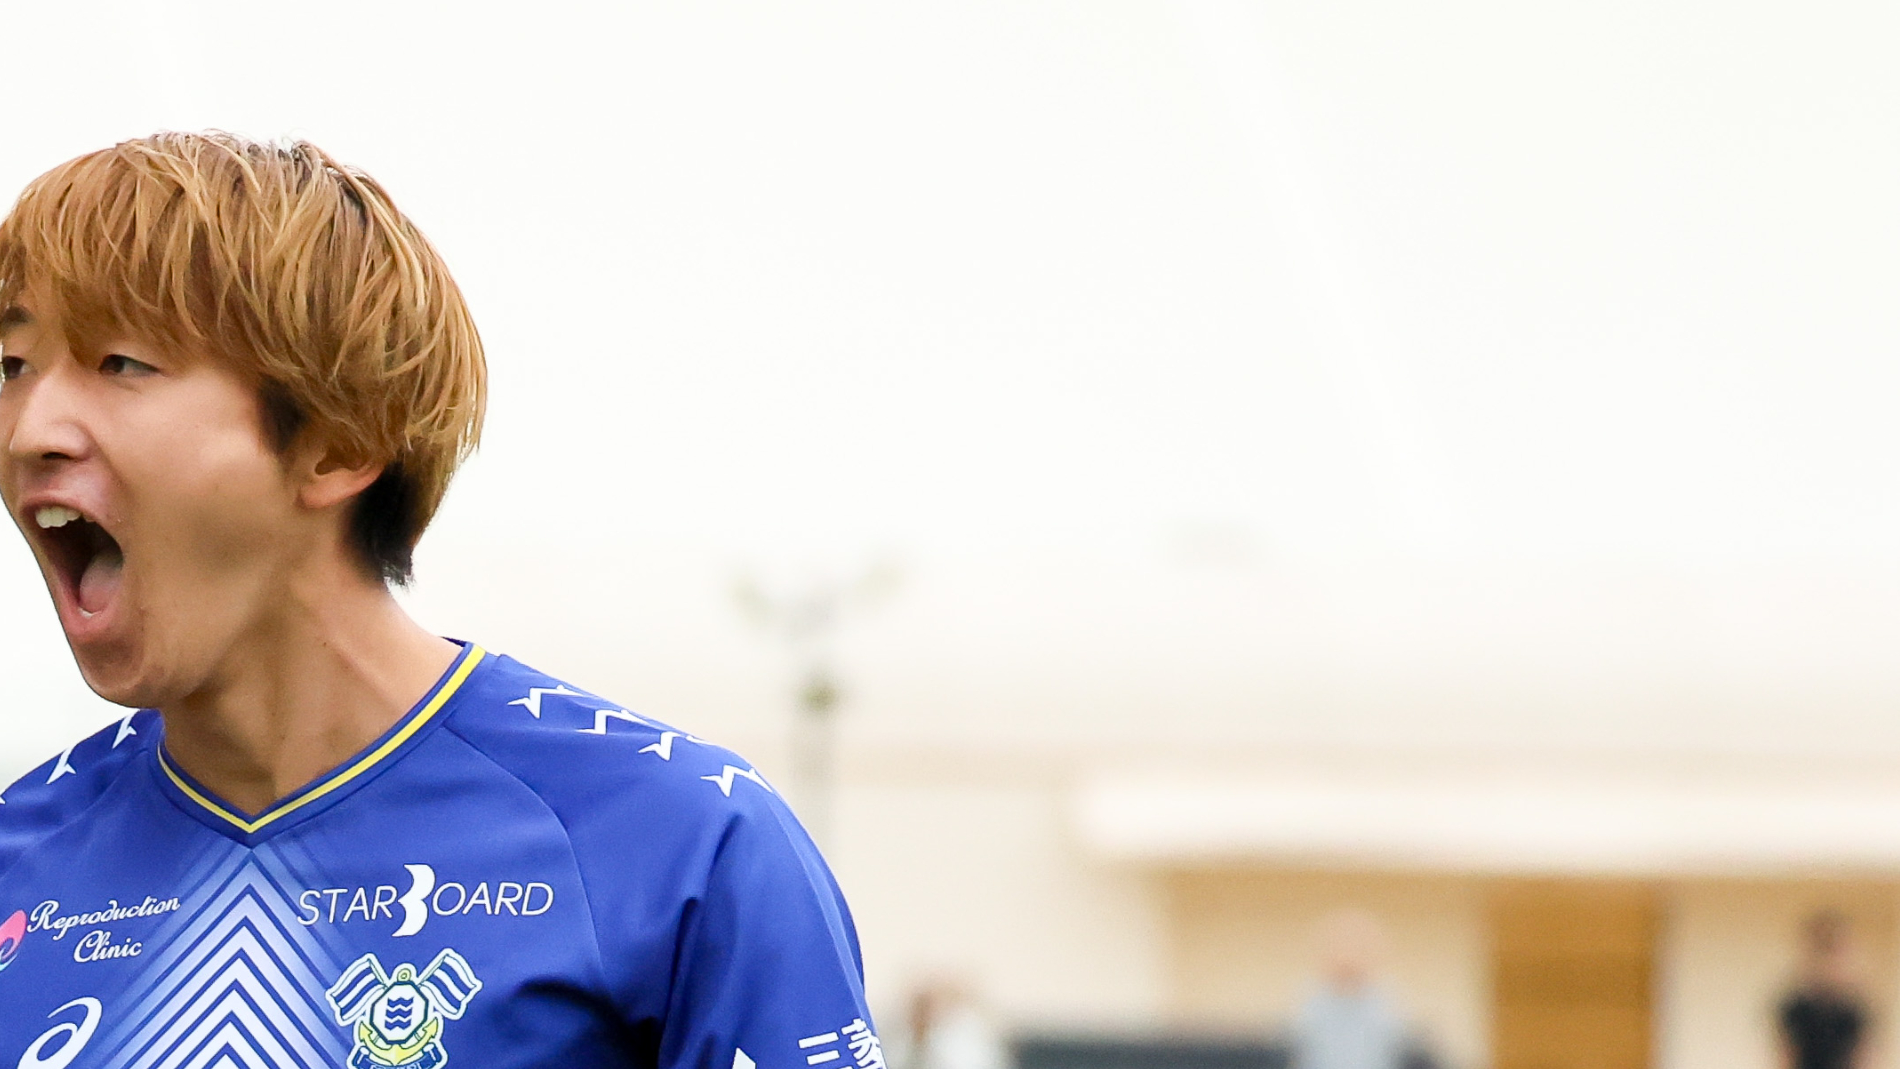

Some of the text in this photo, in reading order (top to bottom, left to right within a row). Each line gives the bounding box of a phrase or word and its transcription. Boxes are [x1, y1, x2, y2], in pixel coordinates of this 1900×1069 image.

[26, 895, 181, 941] Reproduction
[296, 863, 555, 937] STARBOARD
[72, 929, 143, 963] Clinic
